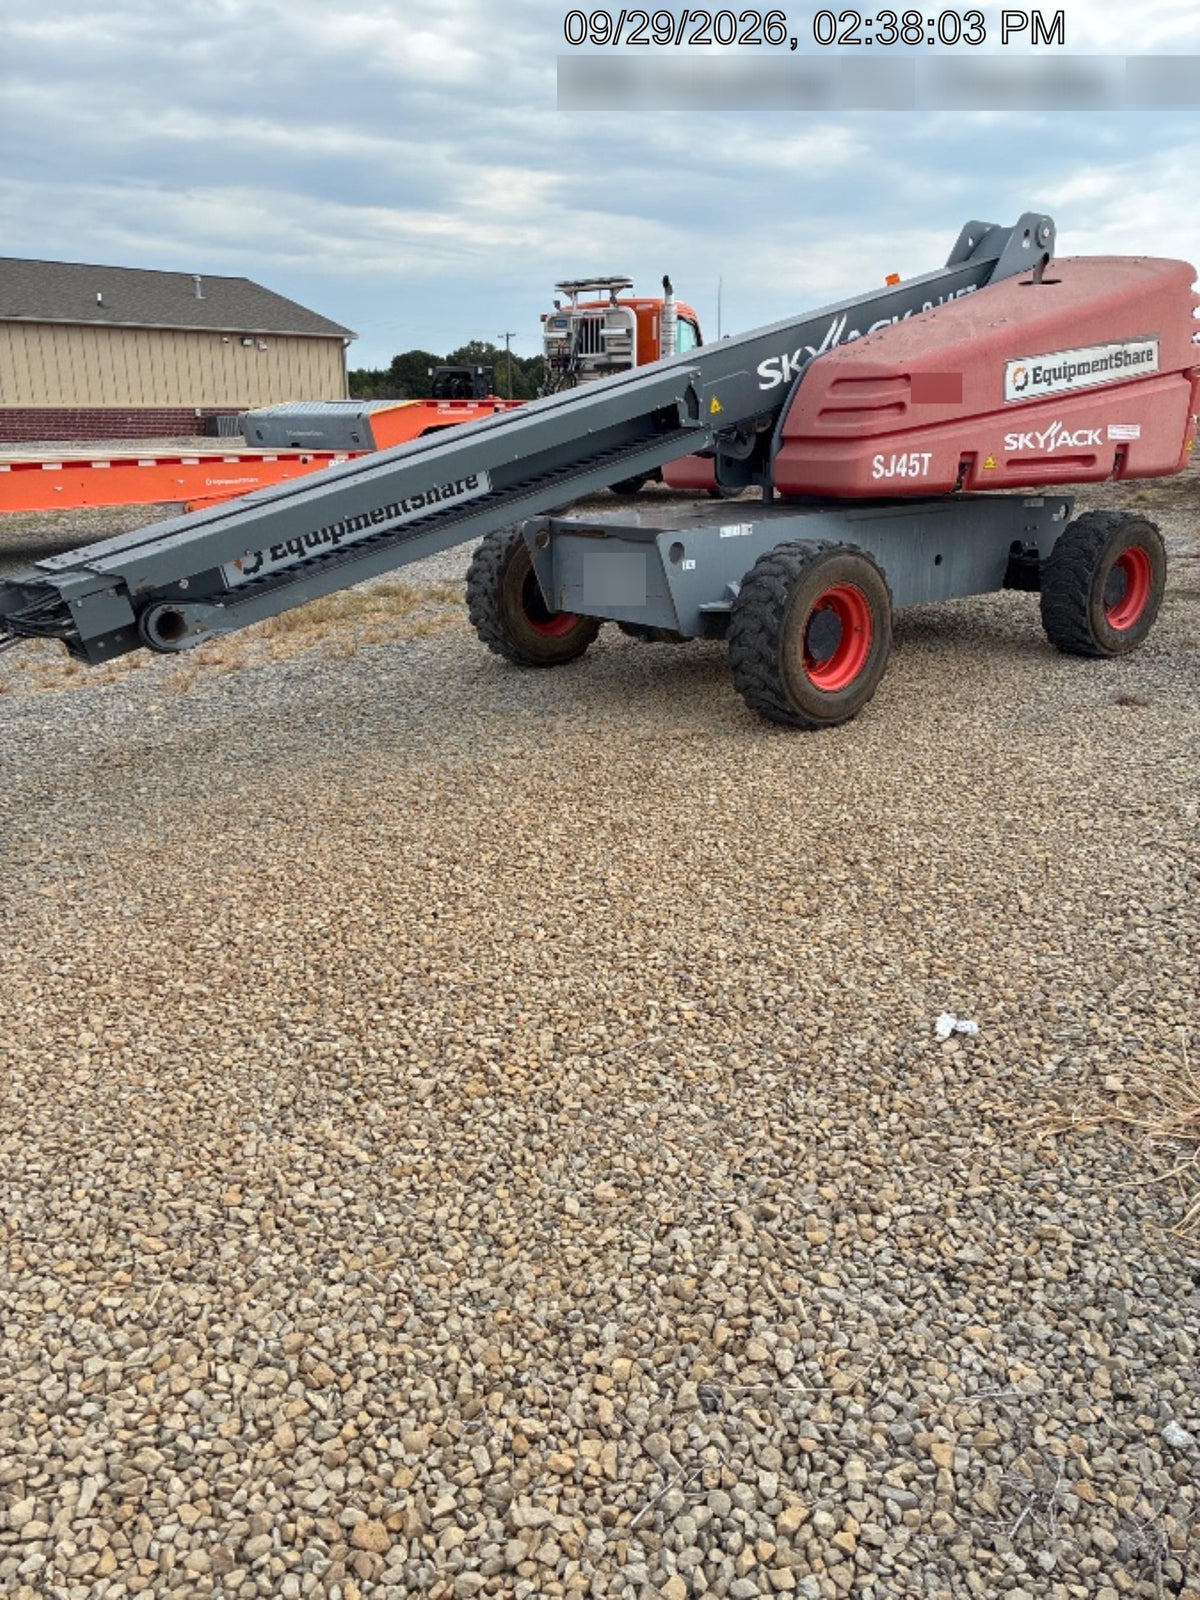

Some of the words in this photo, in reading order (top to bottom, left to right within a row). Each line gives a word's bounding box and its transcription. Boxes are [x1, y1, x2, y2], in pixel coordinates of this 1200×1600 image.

[1032, 348, 1154, 387] EquipmentShare
[1004, 420, 1103, 452] SKYJACK
[872, 453, 933, 479] SJ45T
